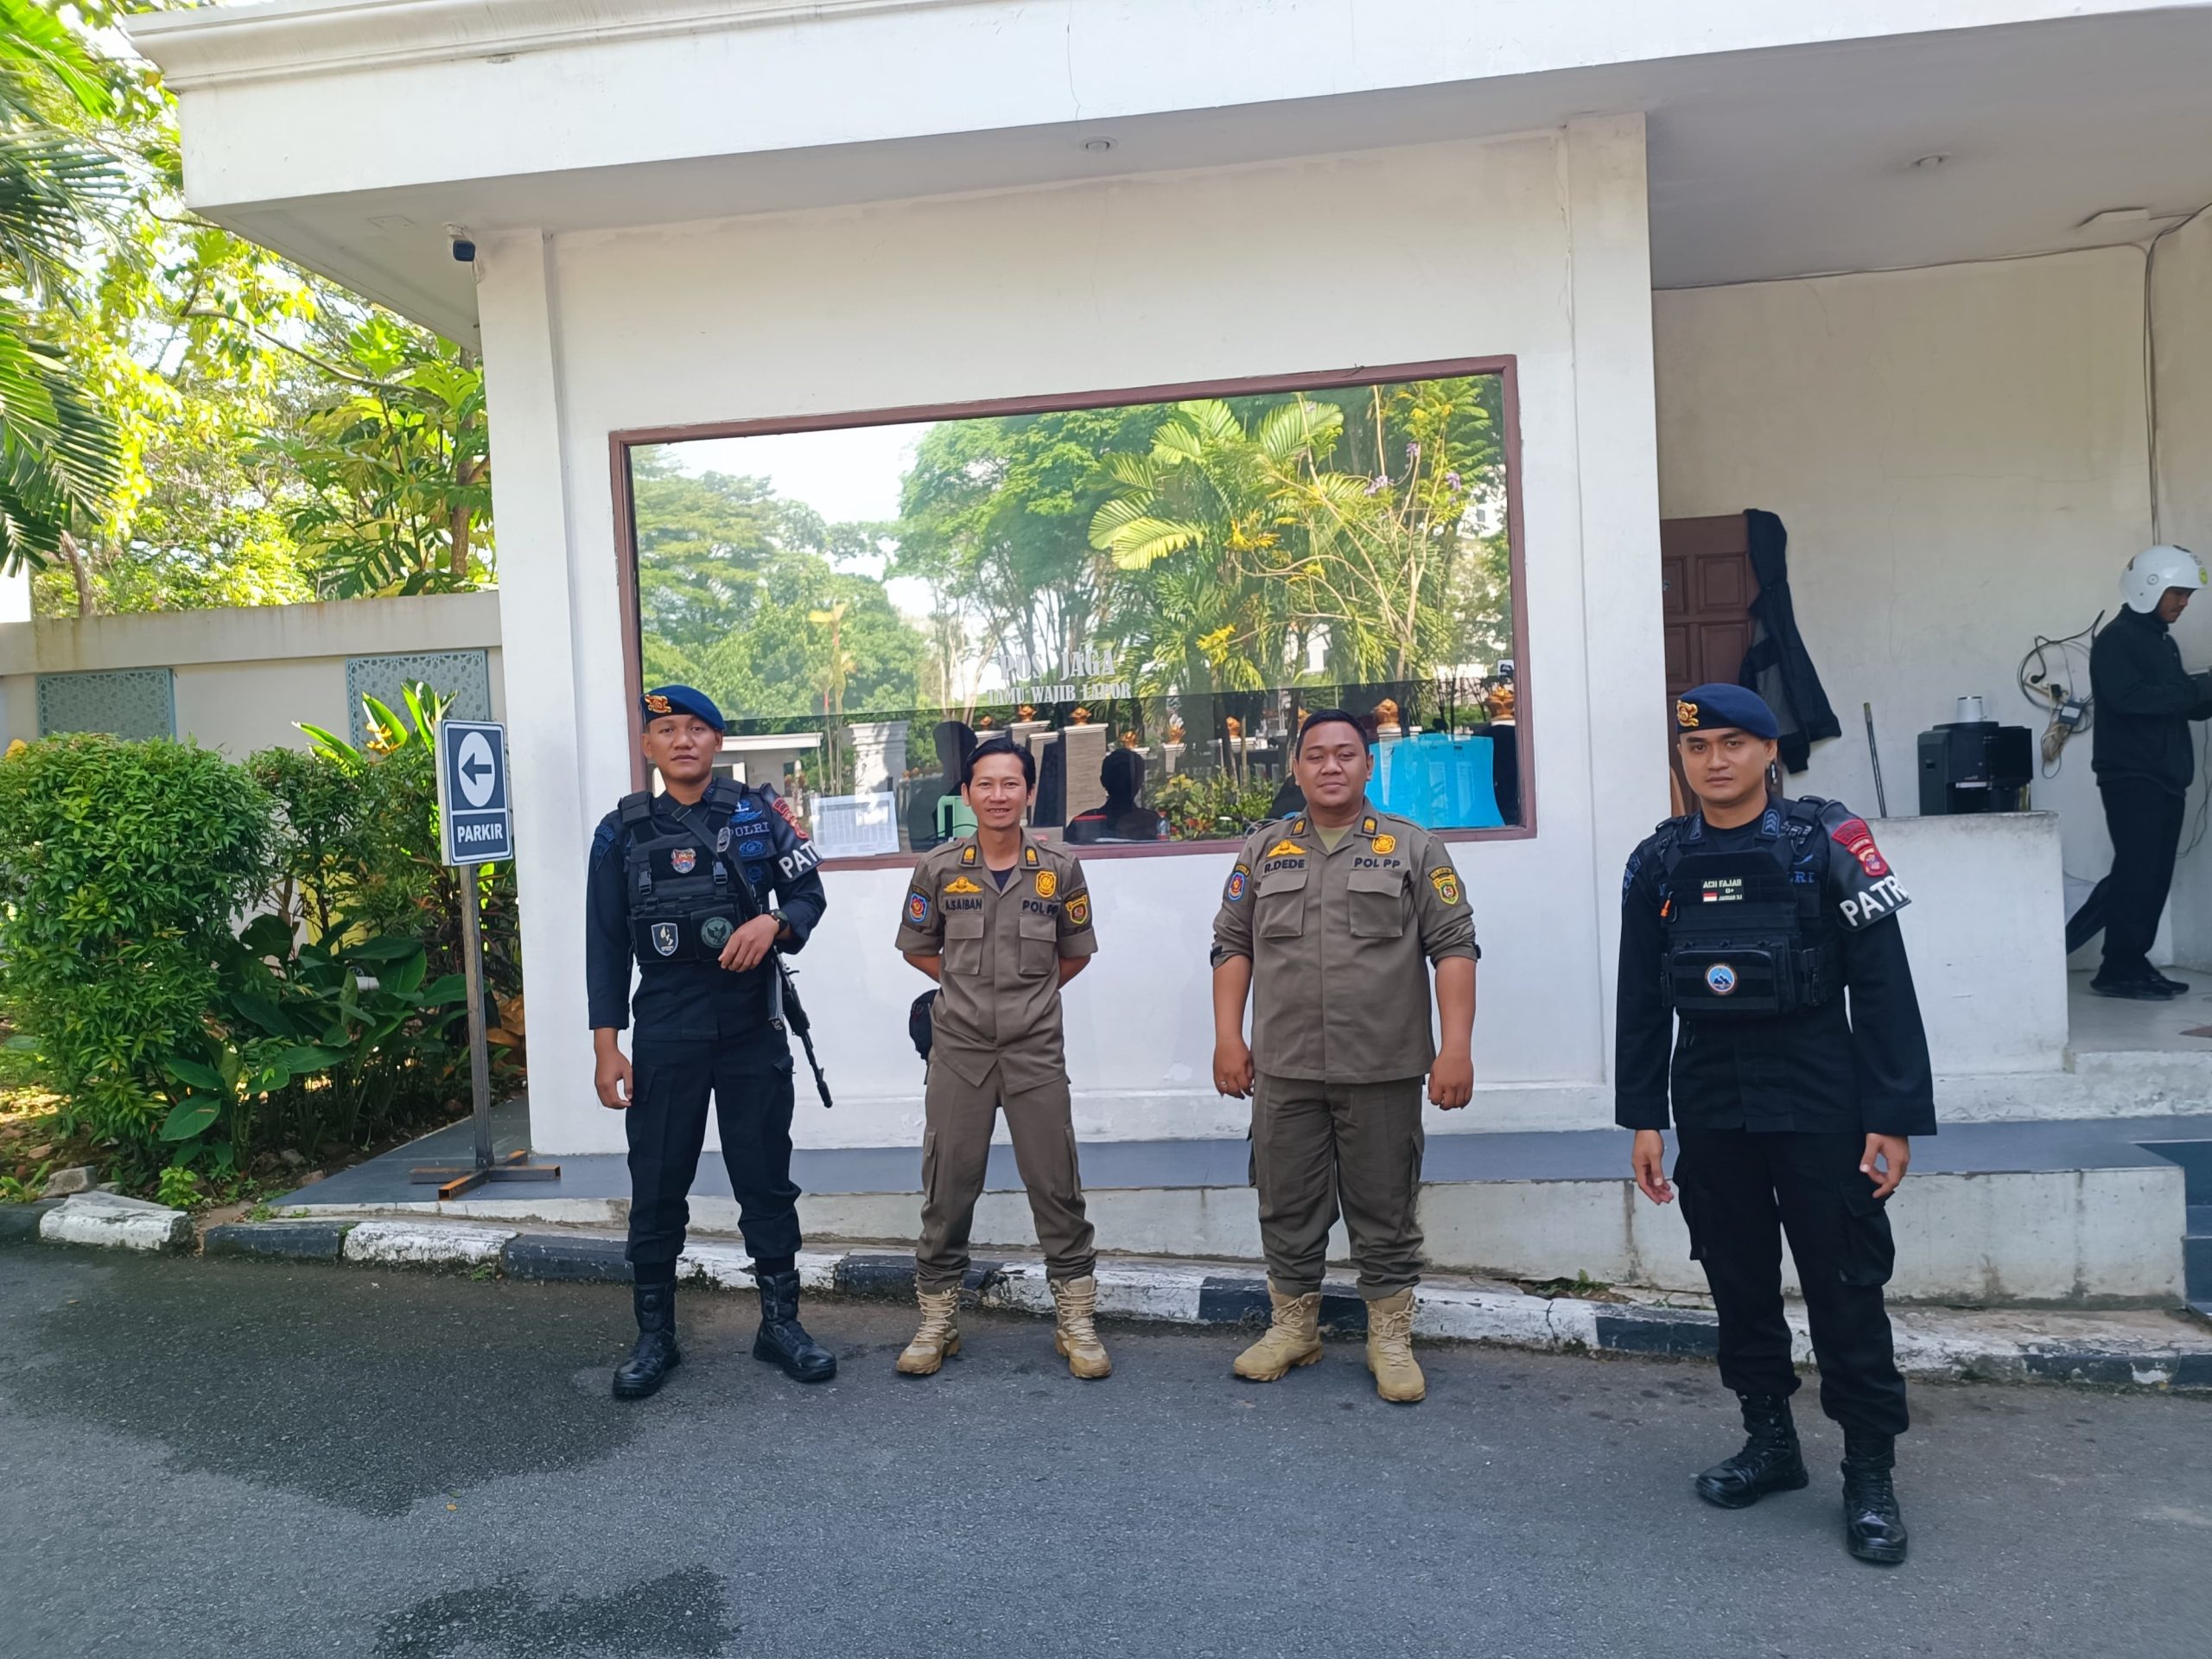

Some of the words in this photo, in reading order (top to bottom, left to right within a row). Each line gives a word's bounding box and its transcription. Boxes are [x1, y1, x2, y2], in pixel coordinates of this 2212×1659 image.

[999, 653, 1044, 680] POS
[1060, 649, 1116, 682] JAGA
[988, 687, 1026, 705] TAMU
[1031, 684, 1077, 704] WAJIB
[1082, 682, 1132, 701] LAPOR
[457, 823, 504, 843] PARKIR
[731, 822, 770, 837] OLRI
[1264, 859, 1306, 874] R.DEDE
[1354, 857, 1380, 868] POL
[1383, 858, 1401, 868] PP
